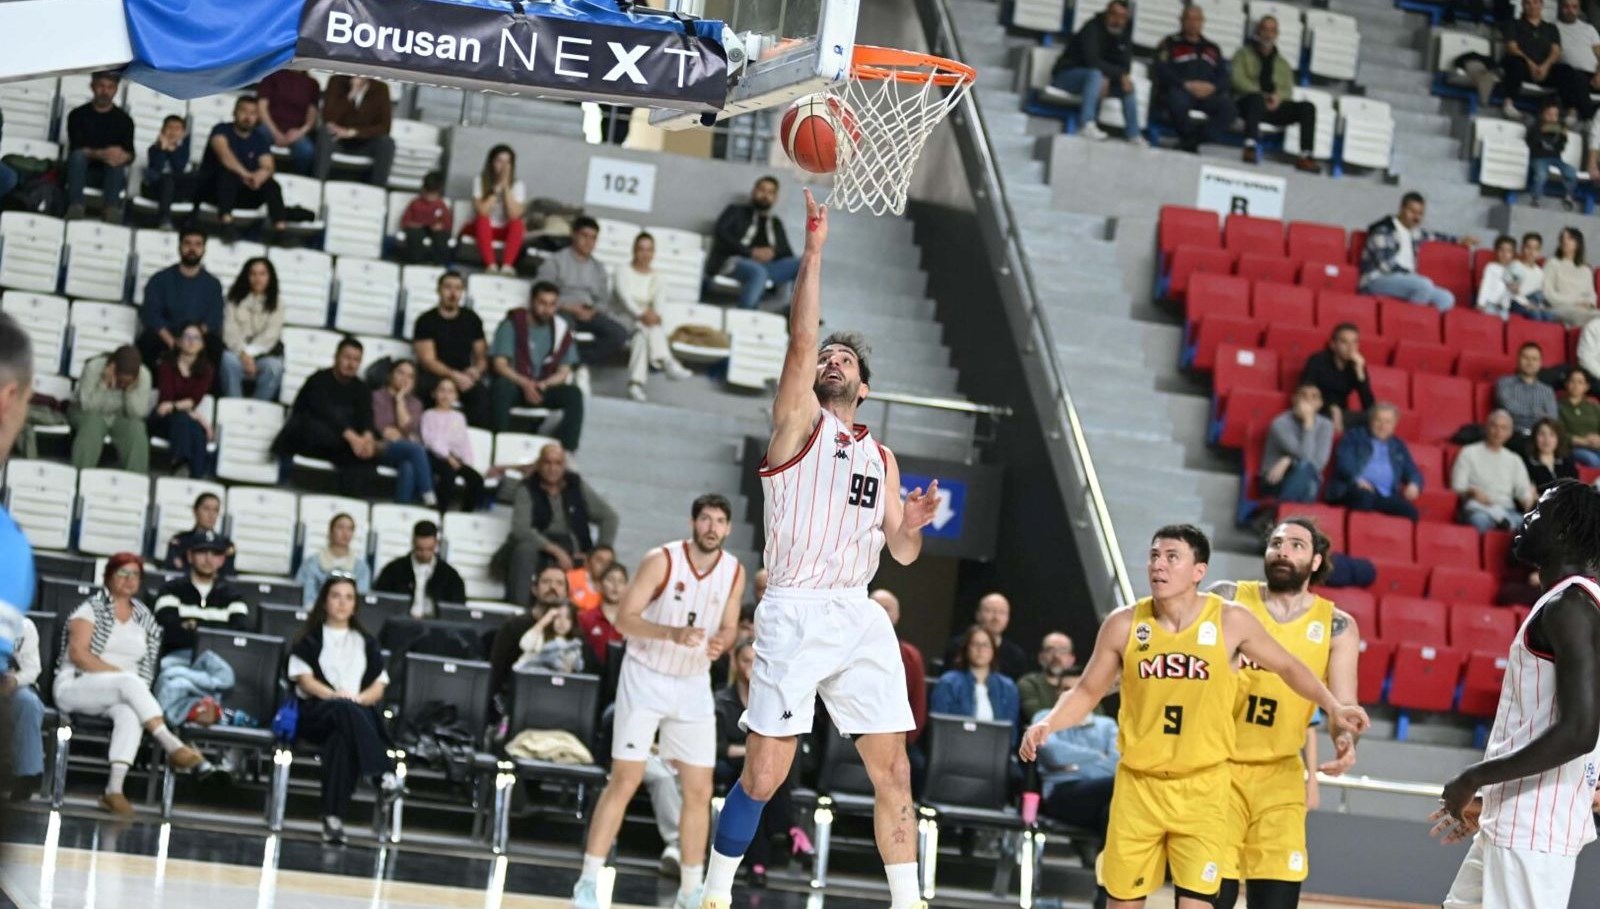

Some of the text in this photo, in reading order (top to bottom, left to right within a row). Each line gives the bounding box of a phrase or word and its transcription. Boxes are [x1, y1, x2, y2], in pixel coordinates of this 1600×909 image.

[326, 11, 700, 88] Borusan NEXT
[603, 173, 639, 195] 102
[849, 473, 879, 509] 99
[1139, 653, 1209, 680] MSK
[1163, 705, 1183, 735] 9
[1245, 695, 1278, 728] 13
